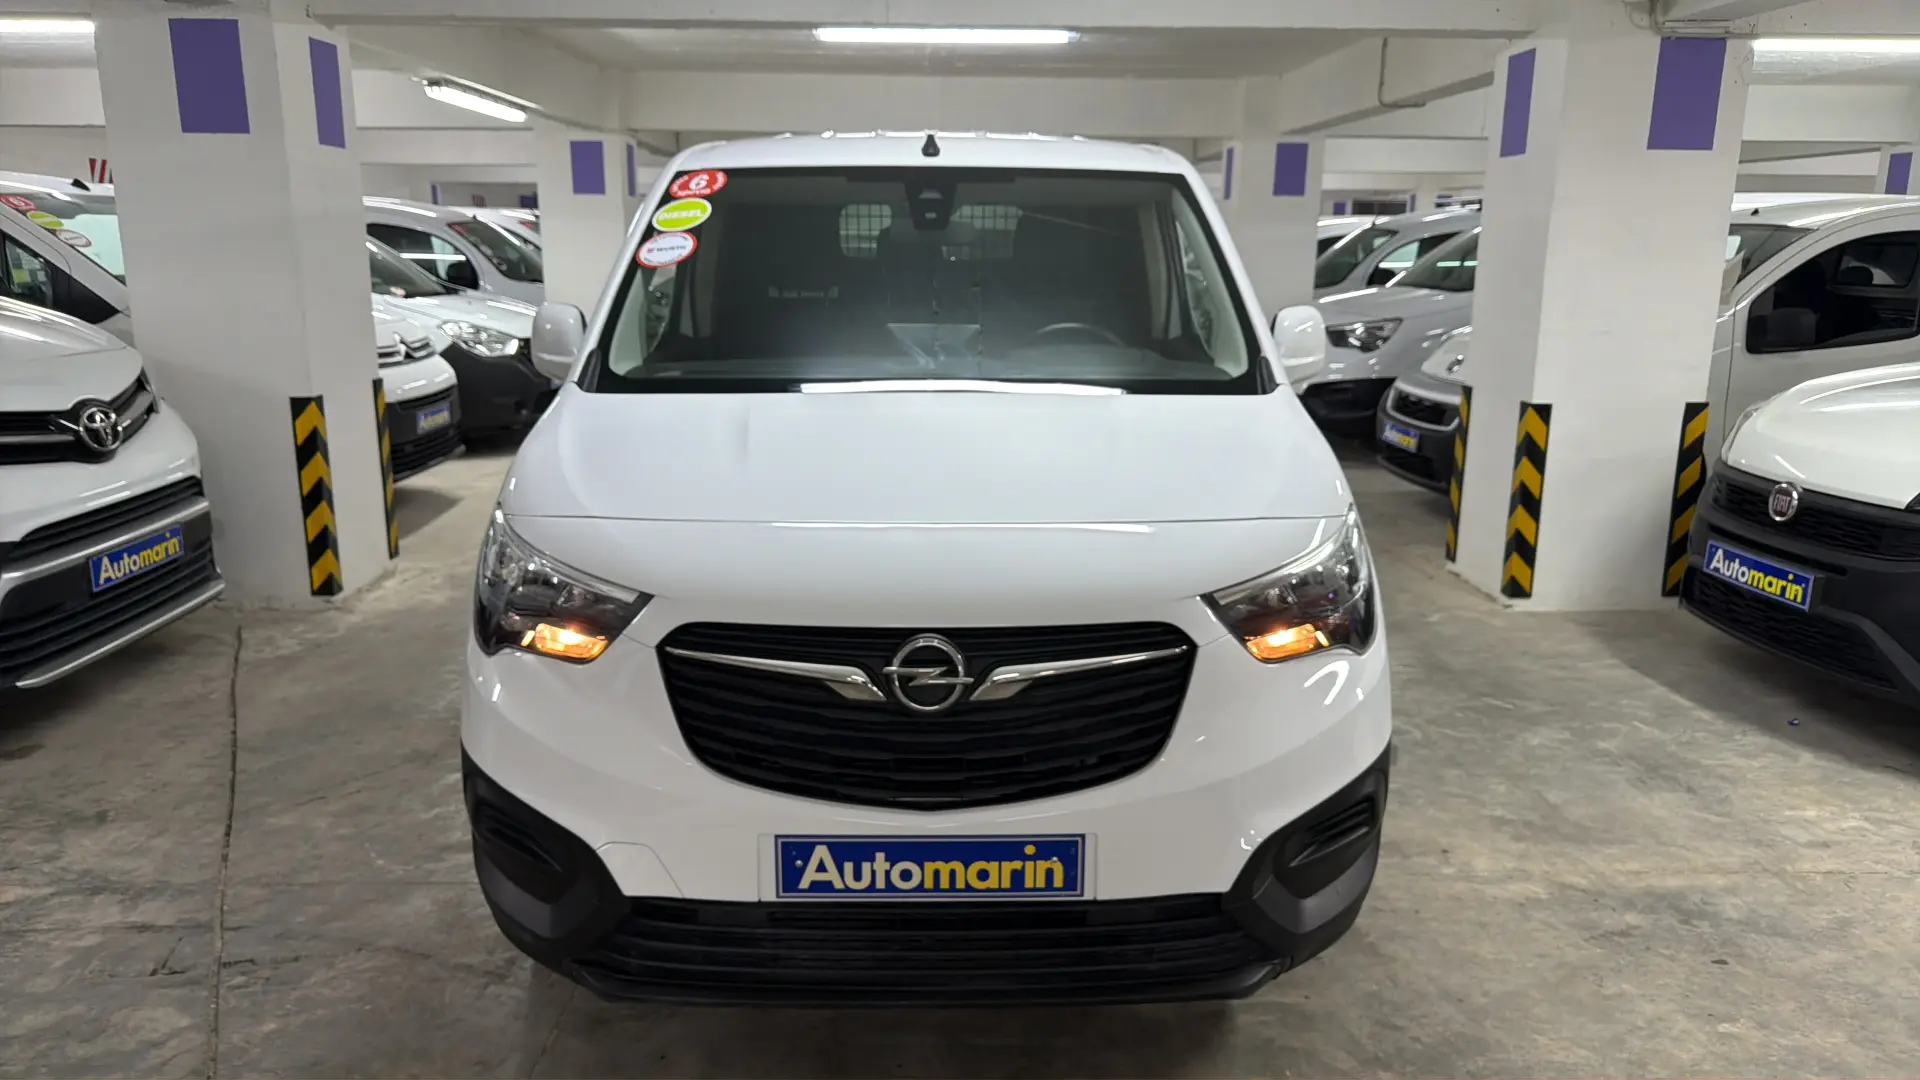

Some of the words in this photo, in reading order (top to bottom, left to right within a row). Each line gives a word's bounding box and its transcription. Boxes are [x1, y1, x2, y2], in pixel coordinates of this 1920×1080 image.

[689, 173, 710, 191] 6
[1775, 494, 1791, 512] FIAT
[99, 532, 180, 585] Automarin
[1709, 548, 1804, 604] Automarin
[797, 844, 1065, 890] Automarin
